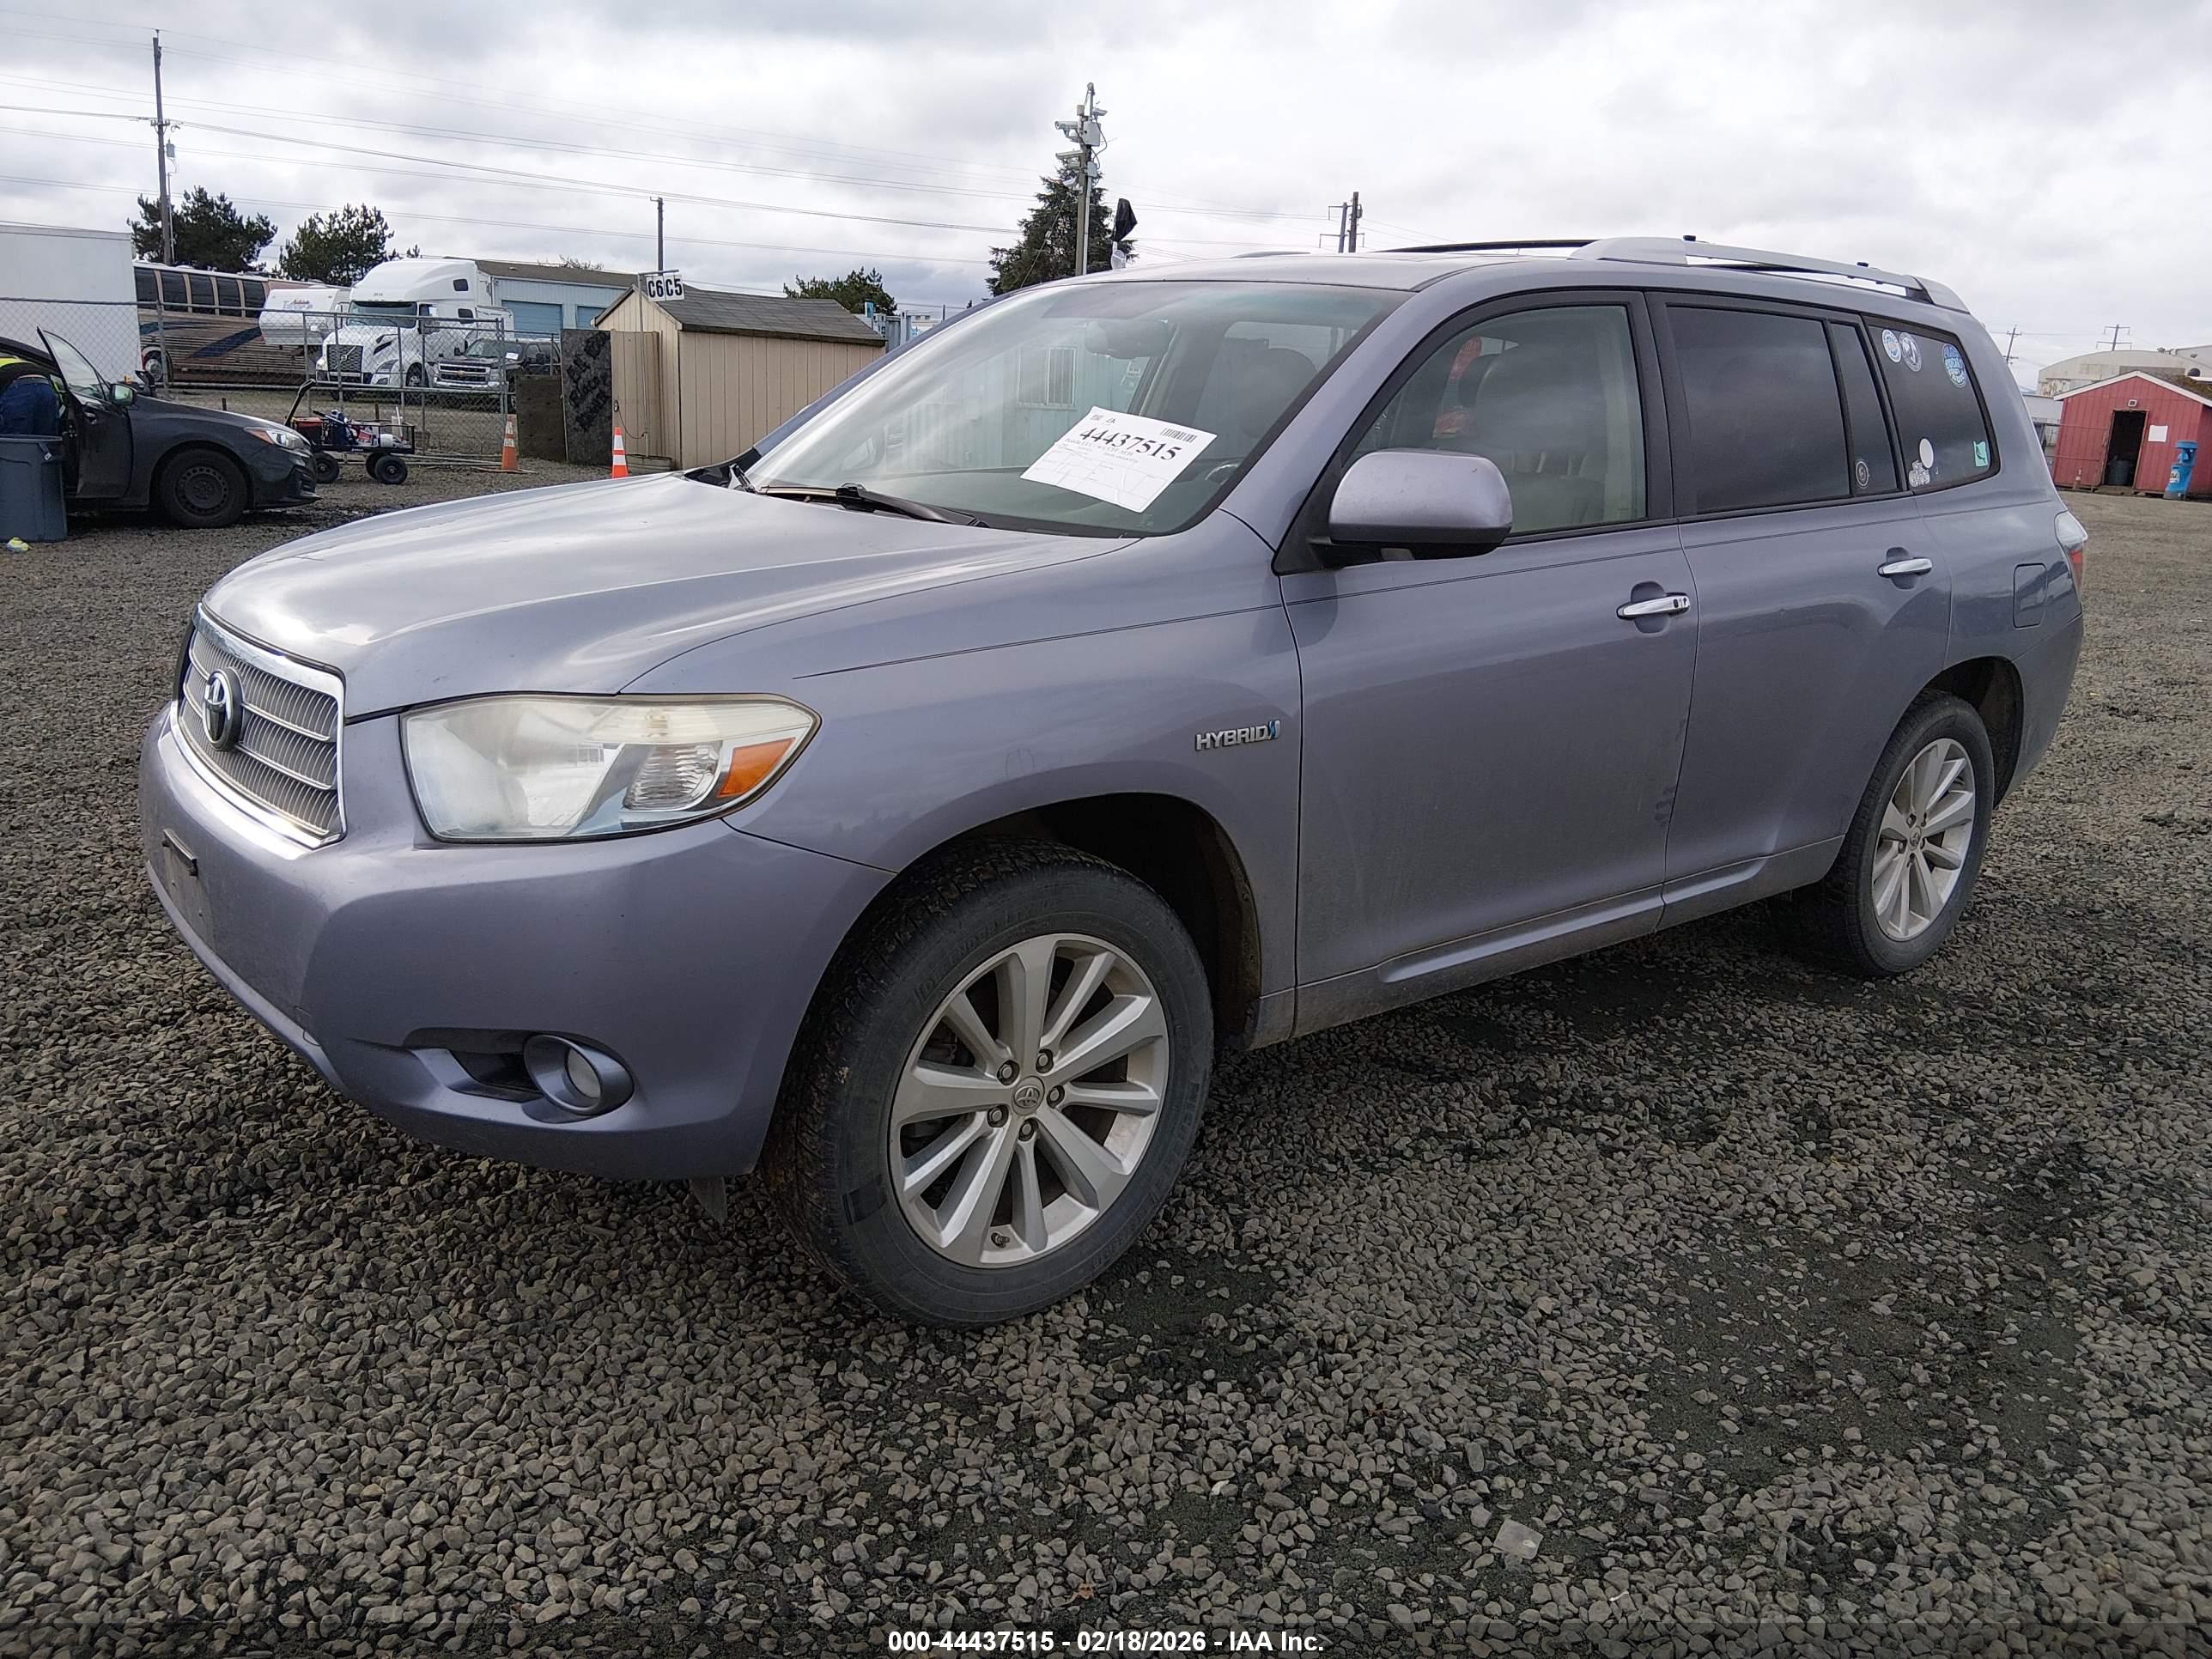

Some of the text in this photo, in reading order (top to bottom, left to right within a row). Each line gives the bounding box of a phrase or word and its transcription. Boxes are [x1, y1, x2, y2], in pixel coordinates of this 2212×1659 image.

[647, 278, 683, 298] C6 C5
[1079, 427, 1182, 461] 44437515
[1195, 725, 1271, 750] HYBRID
